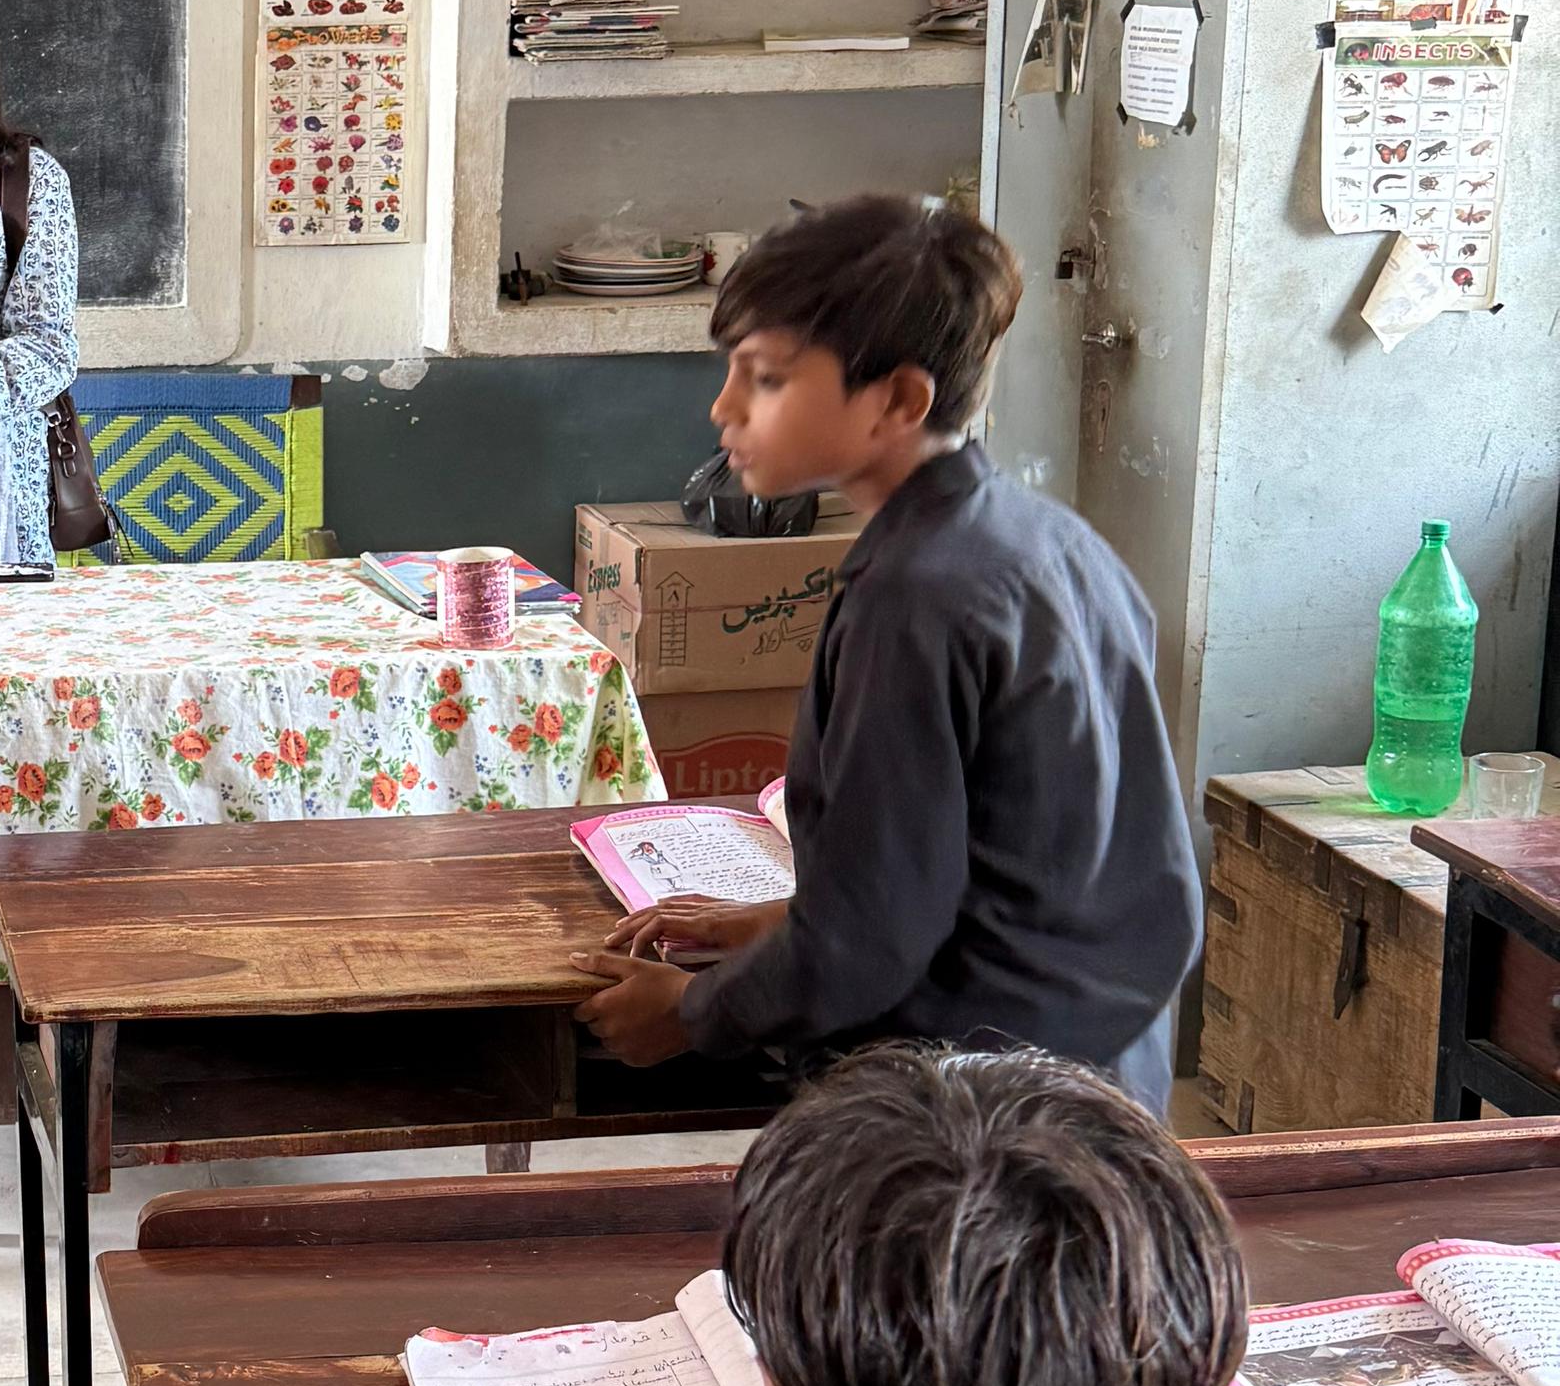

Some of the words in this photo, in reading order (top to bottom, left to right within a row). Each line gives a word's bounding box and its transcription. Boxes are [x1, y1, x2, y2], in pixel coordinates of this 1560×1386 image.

[296, 28, 383, 45] FLOWERS
[1373, 43, 1474, 61] INSECTS
[674, 761, 783, 796] Lipto
